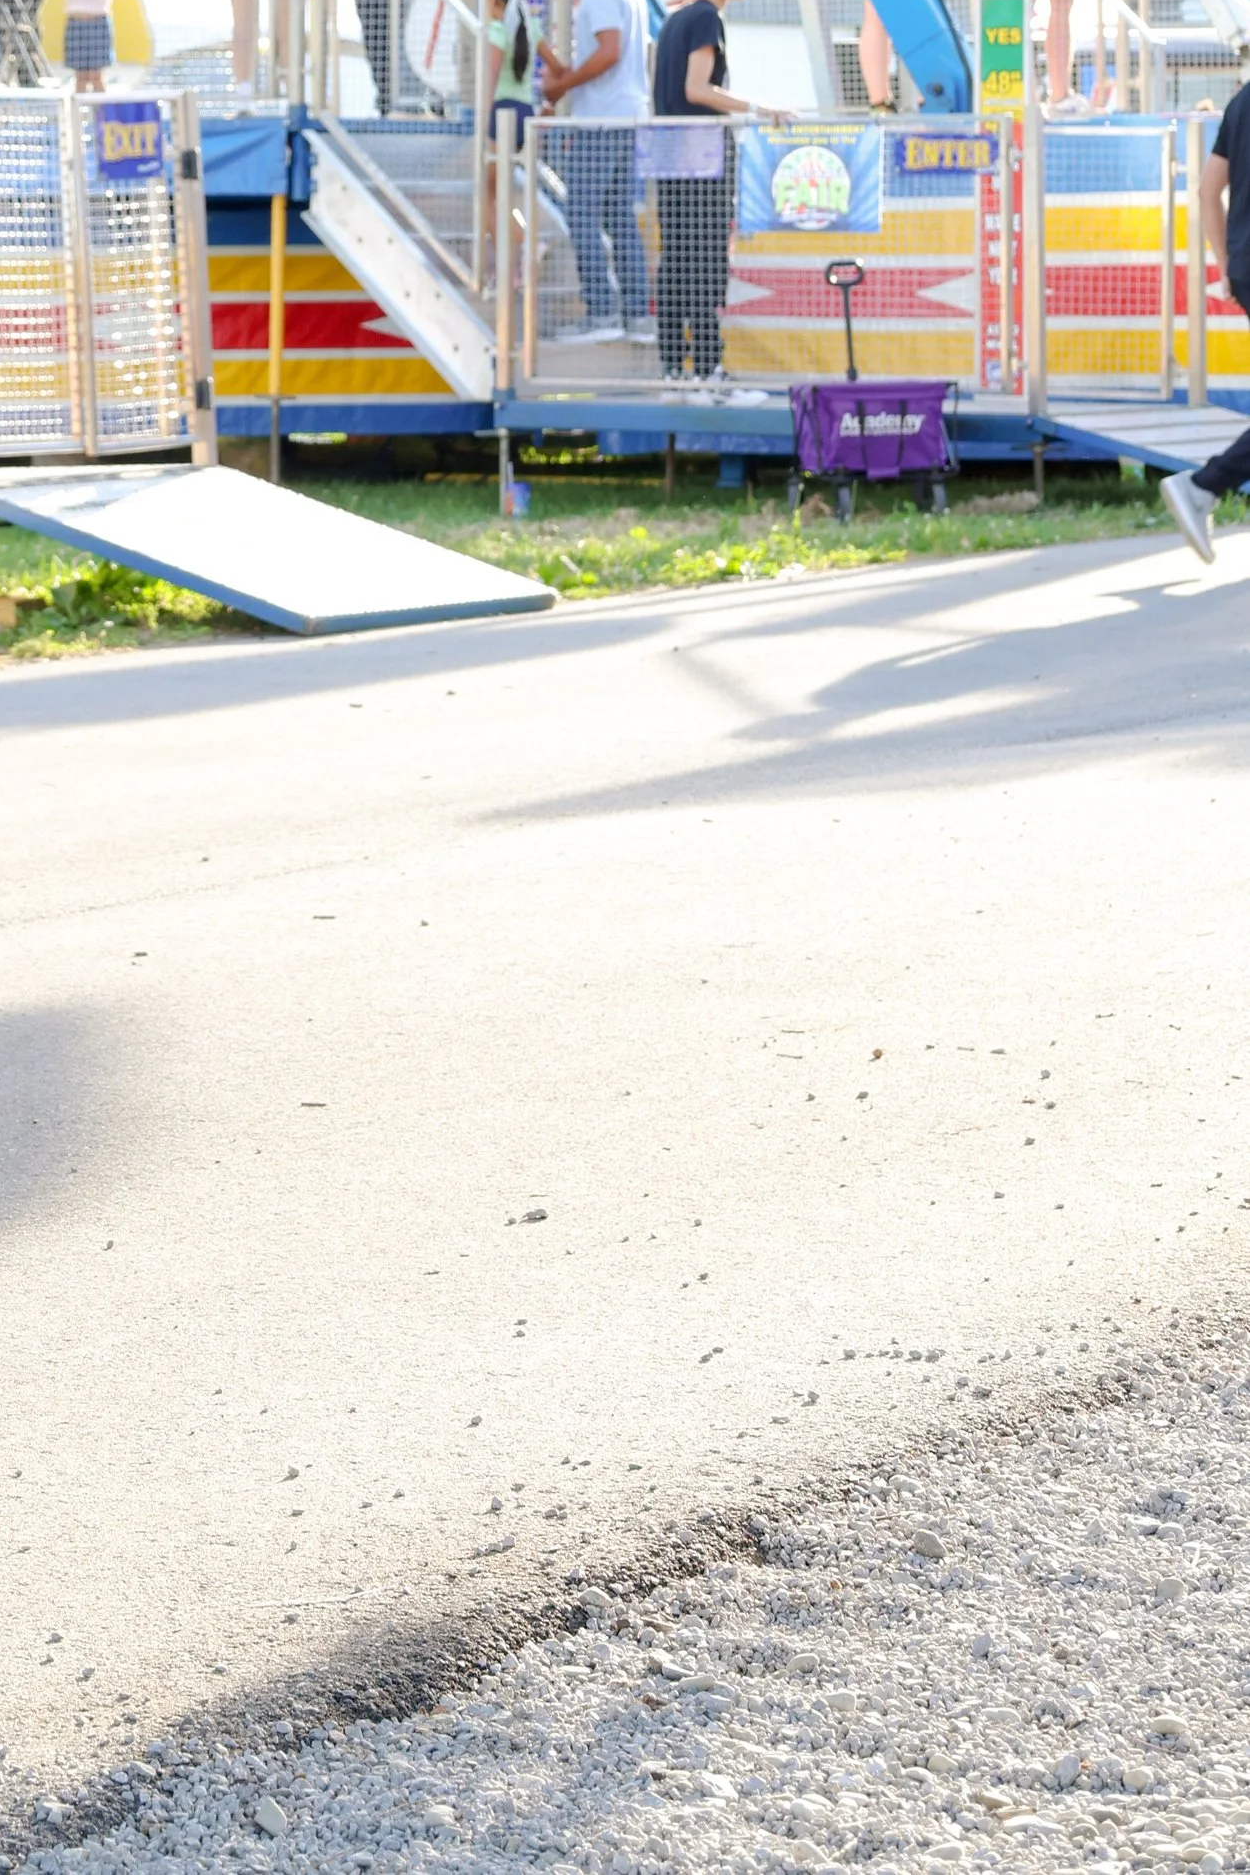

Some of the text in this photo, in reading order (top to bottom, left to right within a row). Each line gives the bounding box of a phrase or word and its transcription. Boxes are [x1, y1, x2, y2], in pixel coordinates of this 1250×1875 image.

[985, 27, 1022, 45] YES
[102, 120, 159, 162] EXIT
[904, 136, 991, 171] ENTER
[774, 177, 850, 216] FAIR
